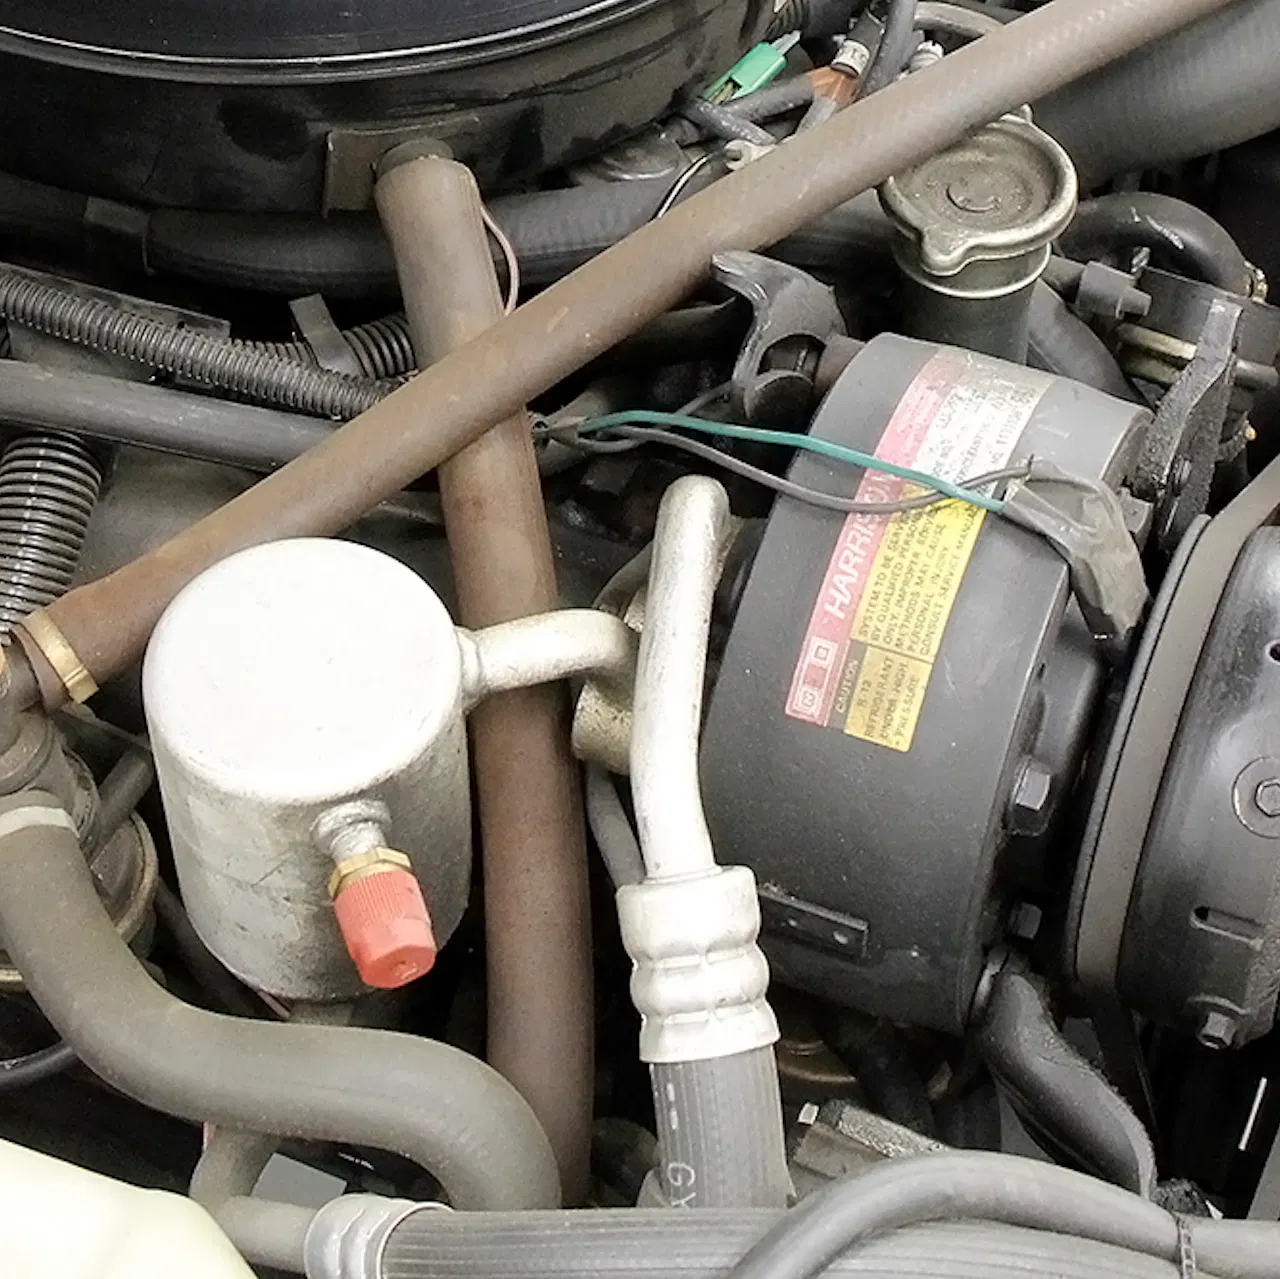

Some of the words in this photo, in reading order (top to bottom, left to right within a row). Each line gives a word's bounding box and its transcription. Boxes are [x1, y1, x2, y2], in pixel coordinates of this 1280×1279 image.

[824, 469, 899, 619] HARRISON
[893, 550, 921, 607] IMPROPER
[894, 589, 920, 648] METHODS
[914, 562, 929, 587] MAY
[924, 521, 946, 559] CAUSE
[858, 588, 880, 636] SYSTEM
[874, 571, 886, 587] TO
[880, 553, 893, 569] BE
[870, 625, 882, 641] BY
[876, 561, 903, 623] QUALIFIED
[906, 591, 933, 652] PERSONAL
[929, 545, 949, 585] INJURY
[918, 601, 944, 656] CONSULT
[938, 552, 961, 599] SERVICE
[834, 658, 859, 713] CAUTION
[864, 655, 894, 737] REFRIGERANT
[879, 697, 897, 739] UNDER
[893, 674, 920, 737] PRESSURE
